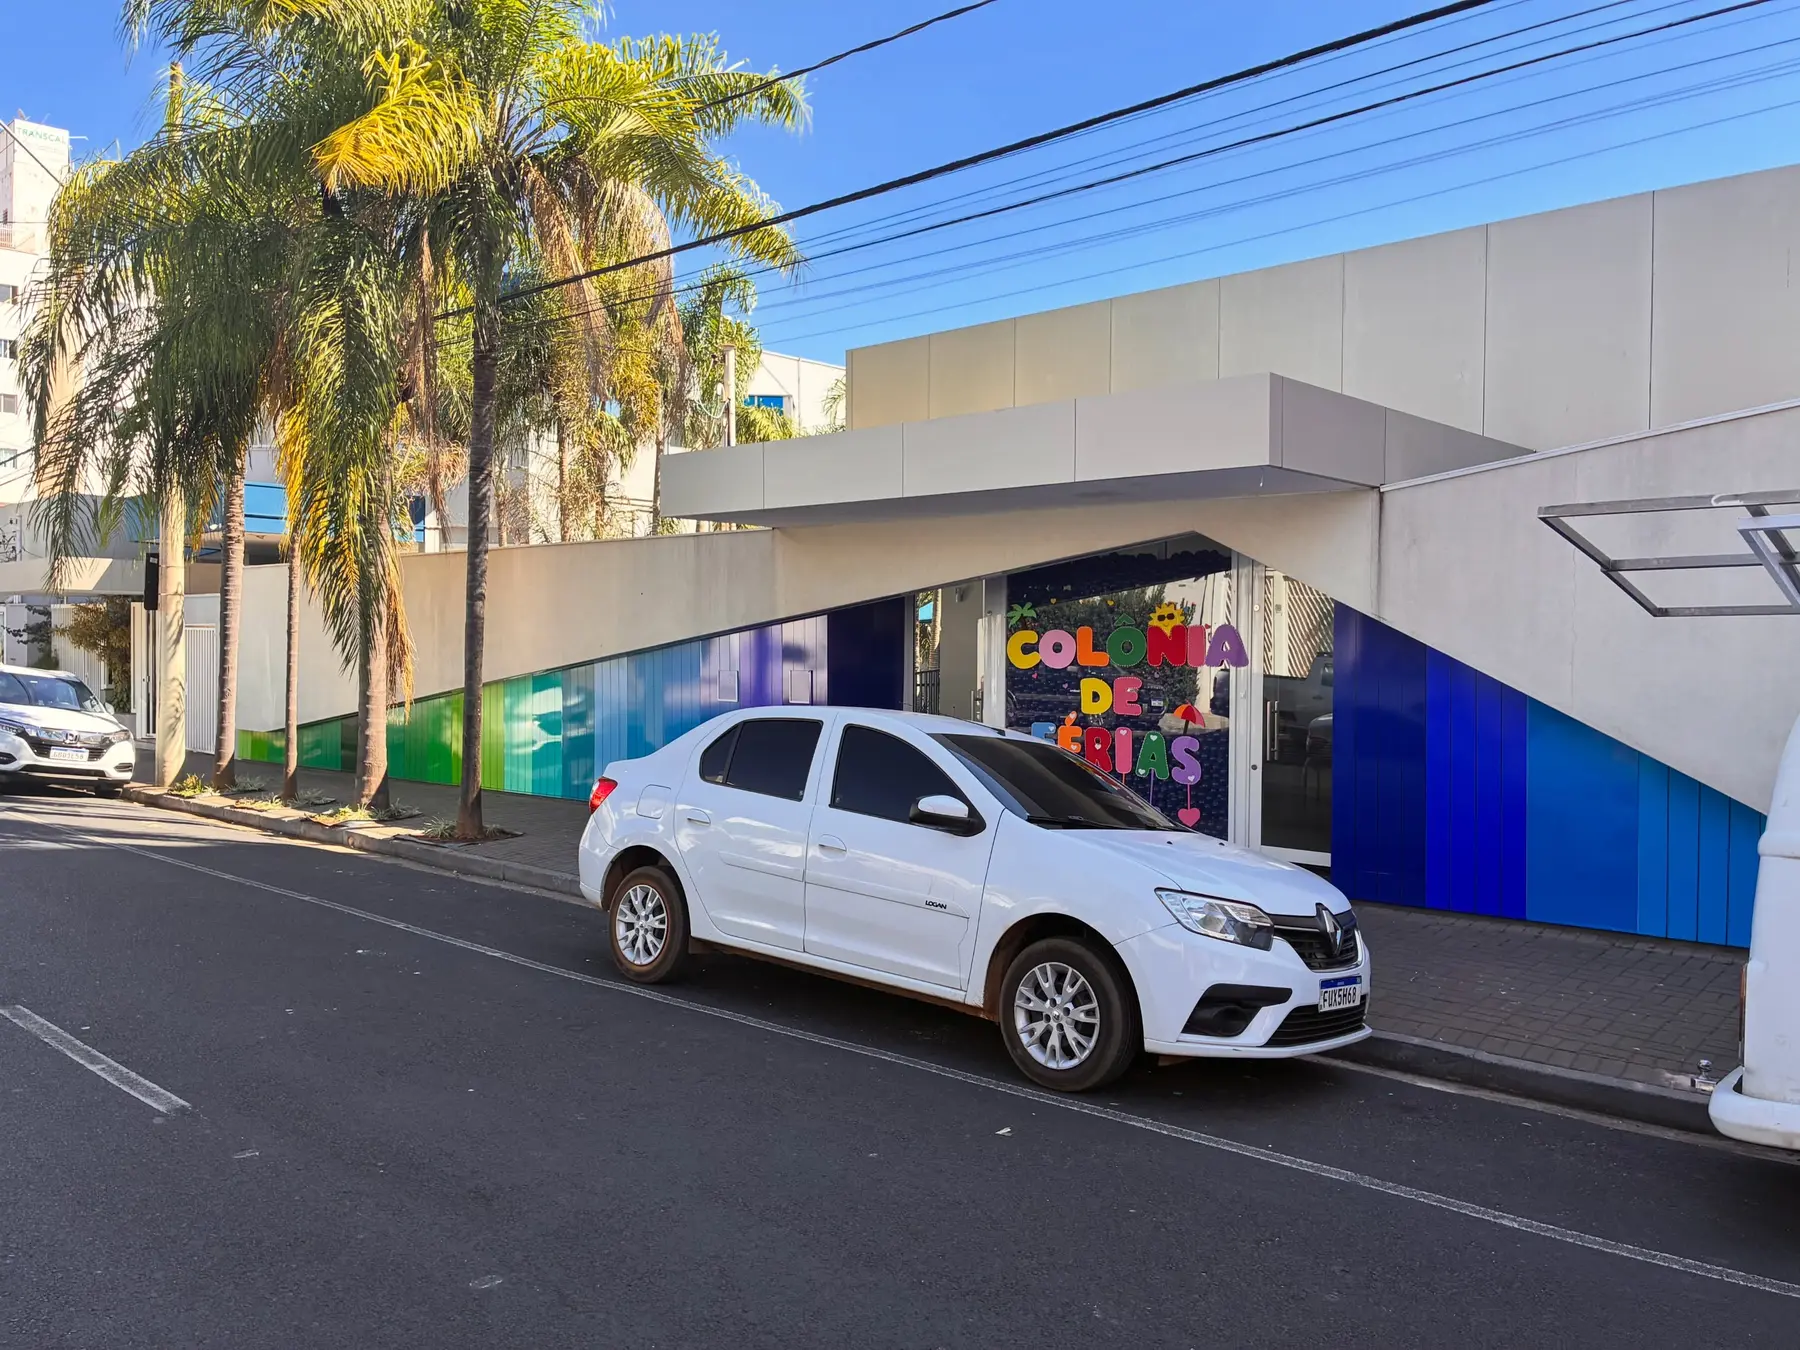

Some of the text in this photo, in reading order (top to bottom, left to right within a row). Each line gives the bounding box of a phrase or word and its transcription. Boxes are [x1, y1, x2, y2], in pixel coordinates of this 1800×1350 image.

[1007, 613, 1249, 669] COLÔNIA
[1080, 677, 1143, 715] DE
[924, 899, 947, 910] LOGAN
[1323, 986, 1357, 1009] FUX5H68
